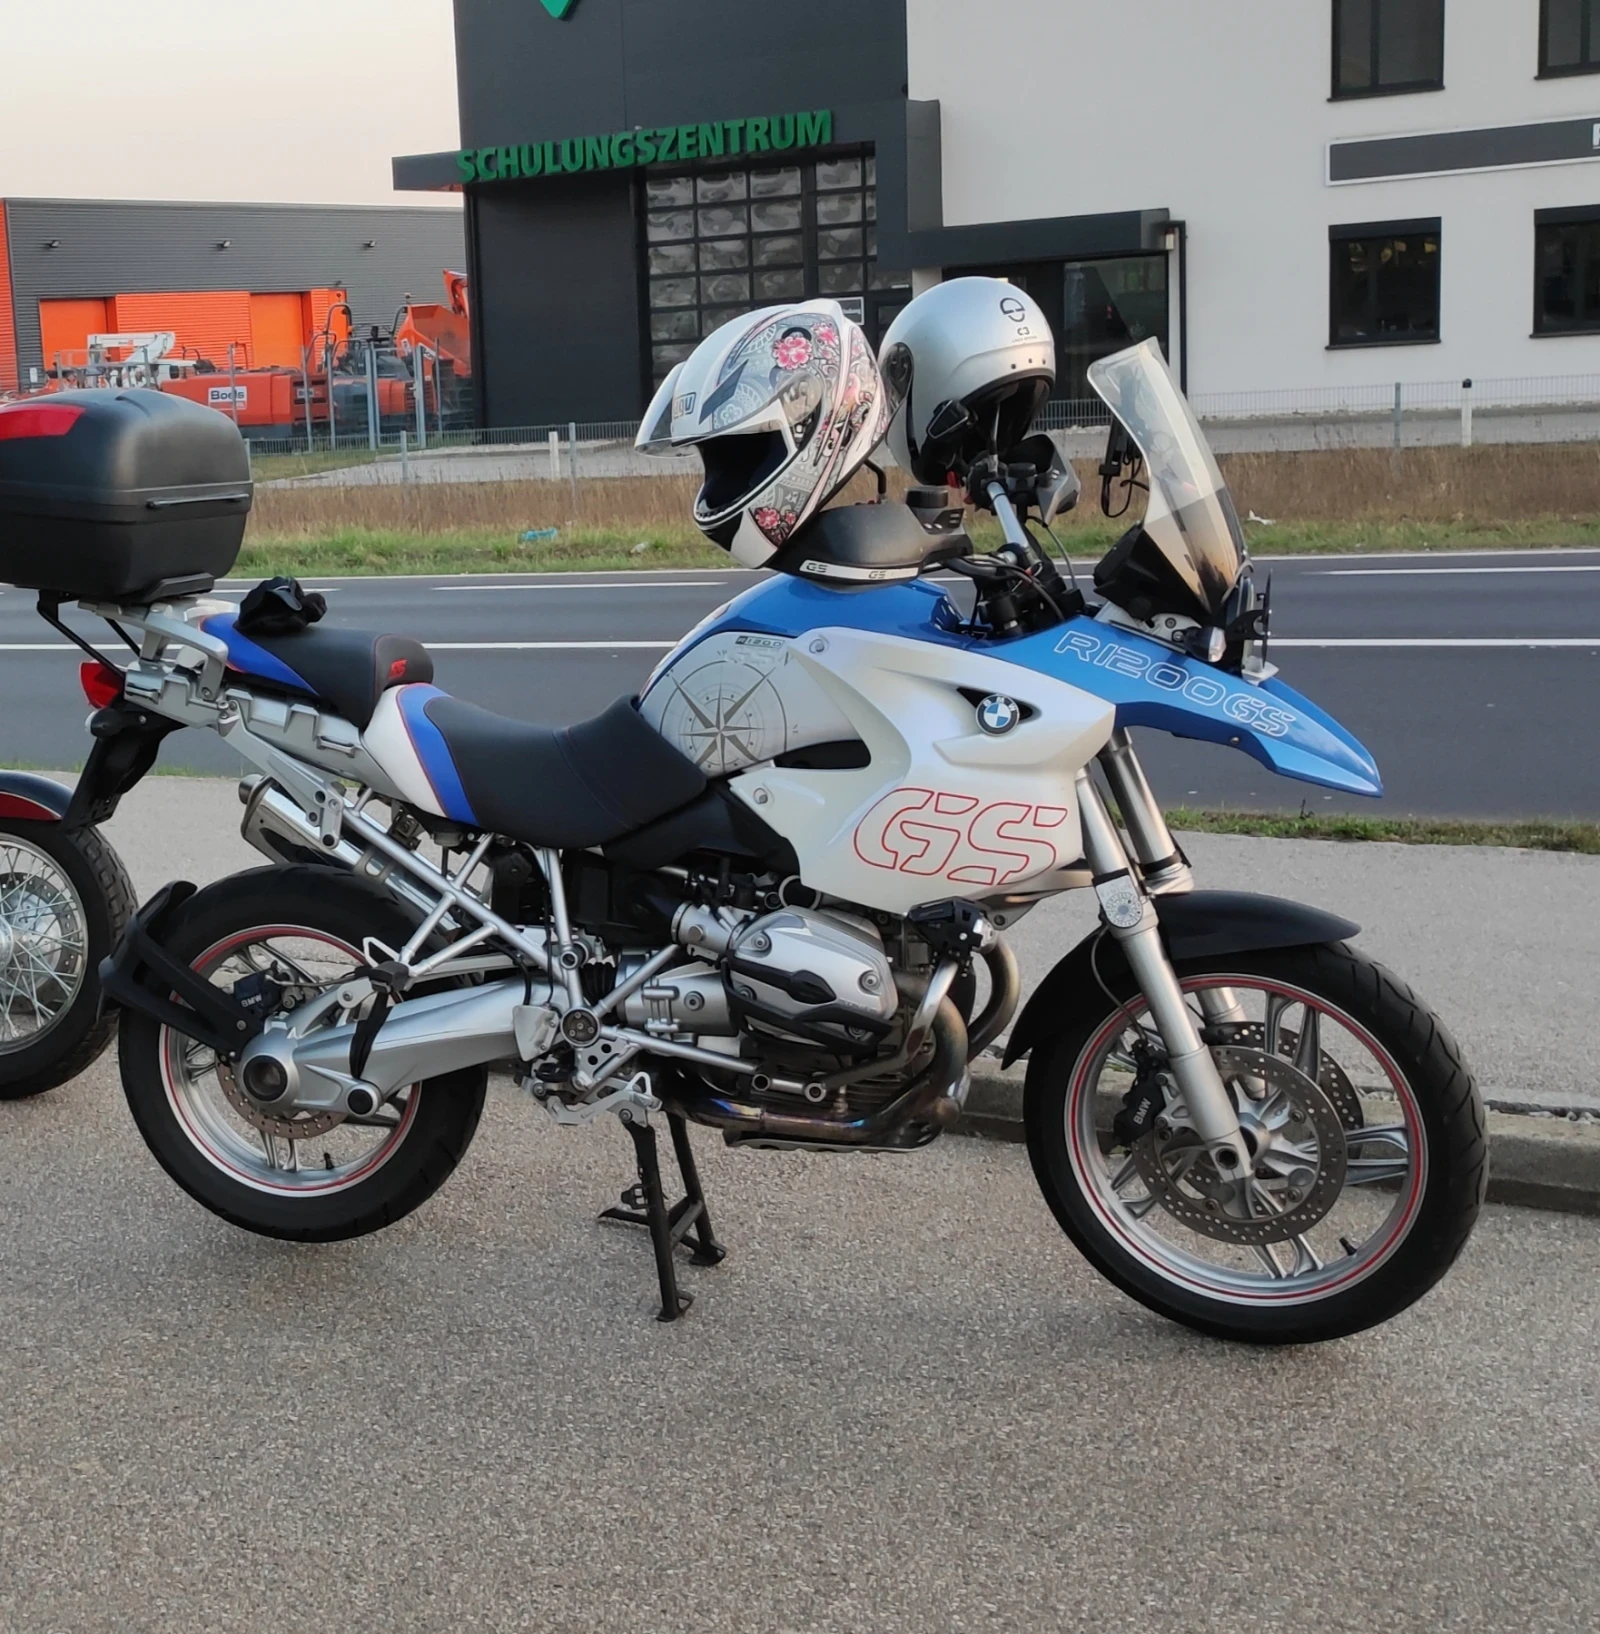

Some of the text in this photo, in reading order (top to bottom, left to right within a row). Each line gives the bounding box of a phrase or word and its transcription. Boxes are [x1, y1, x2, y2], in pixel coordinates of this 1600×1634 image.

[456, 109, 832, 184] SCHULUNGSZENTRUM
[1017, 326, 1030, 336] C3
[805, 562, 828, 574] GS
[868, 570, 887, 580] GS
[853, 787, 1068, 885] GS
[240, 993, 262, 1008] BMW
[1133, 1097, 1152, 1125] BMW
